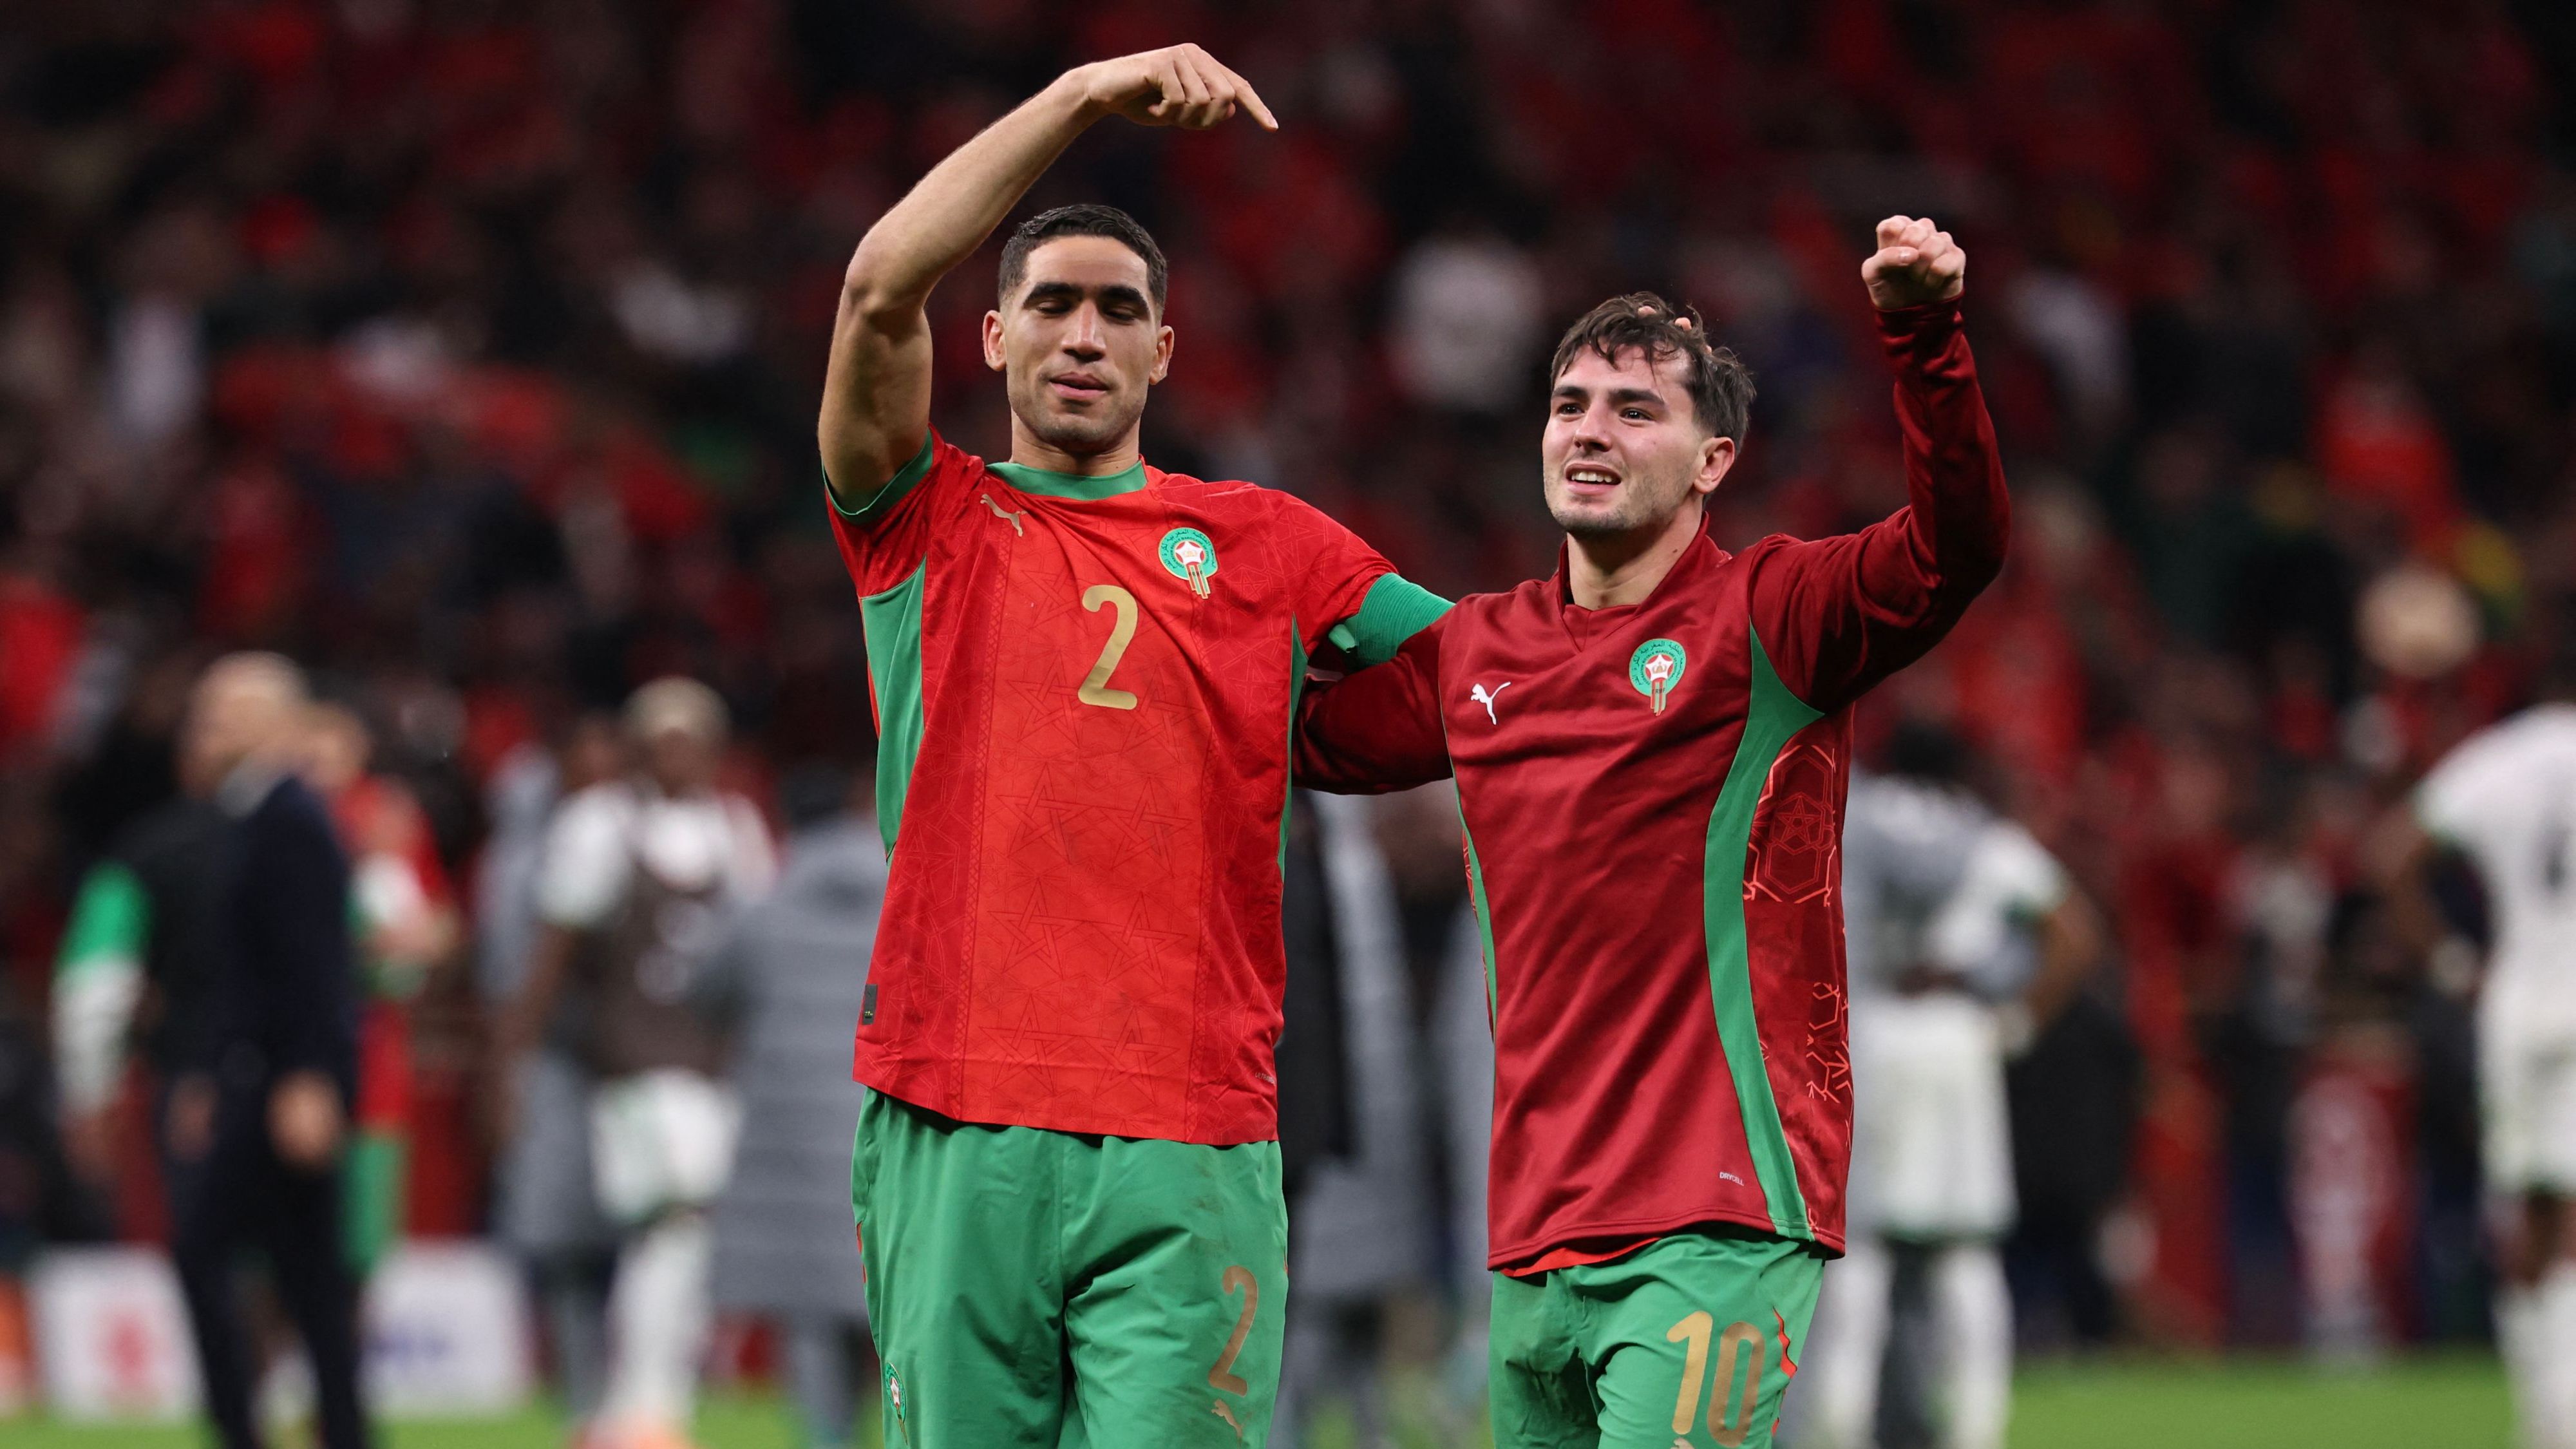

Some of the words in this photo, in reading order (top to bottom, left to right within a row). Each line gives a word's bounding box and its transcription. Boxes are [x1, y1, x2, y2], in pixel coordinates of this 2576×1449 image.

[1078, 585, 1138, 710] 2
[1719, 1171, 1745, 1186] DRYCELL
[1208, 1265, 1258, 1397] 2
[1666, 1311, 1765, 1448] 10
